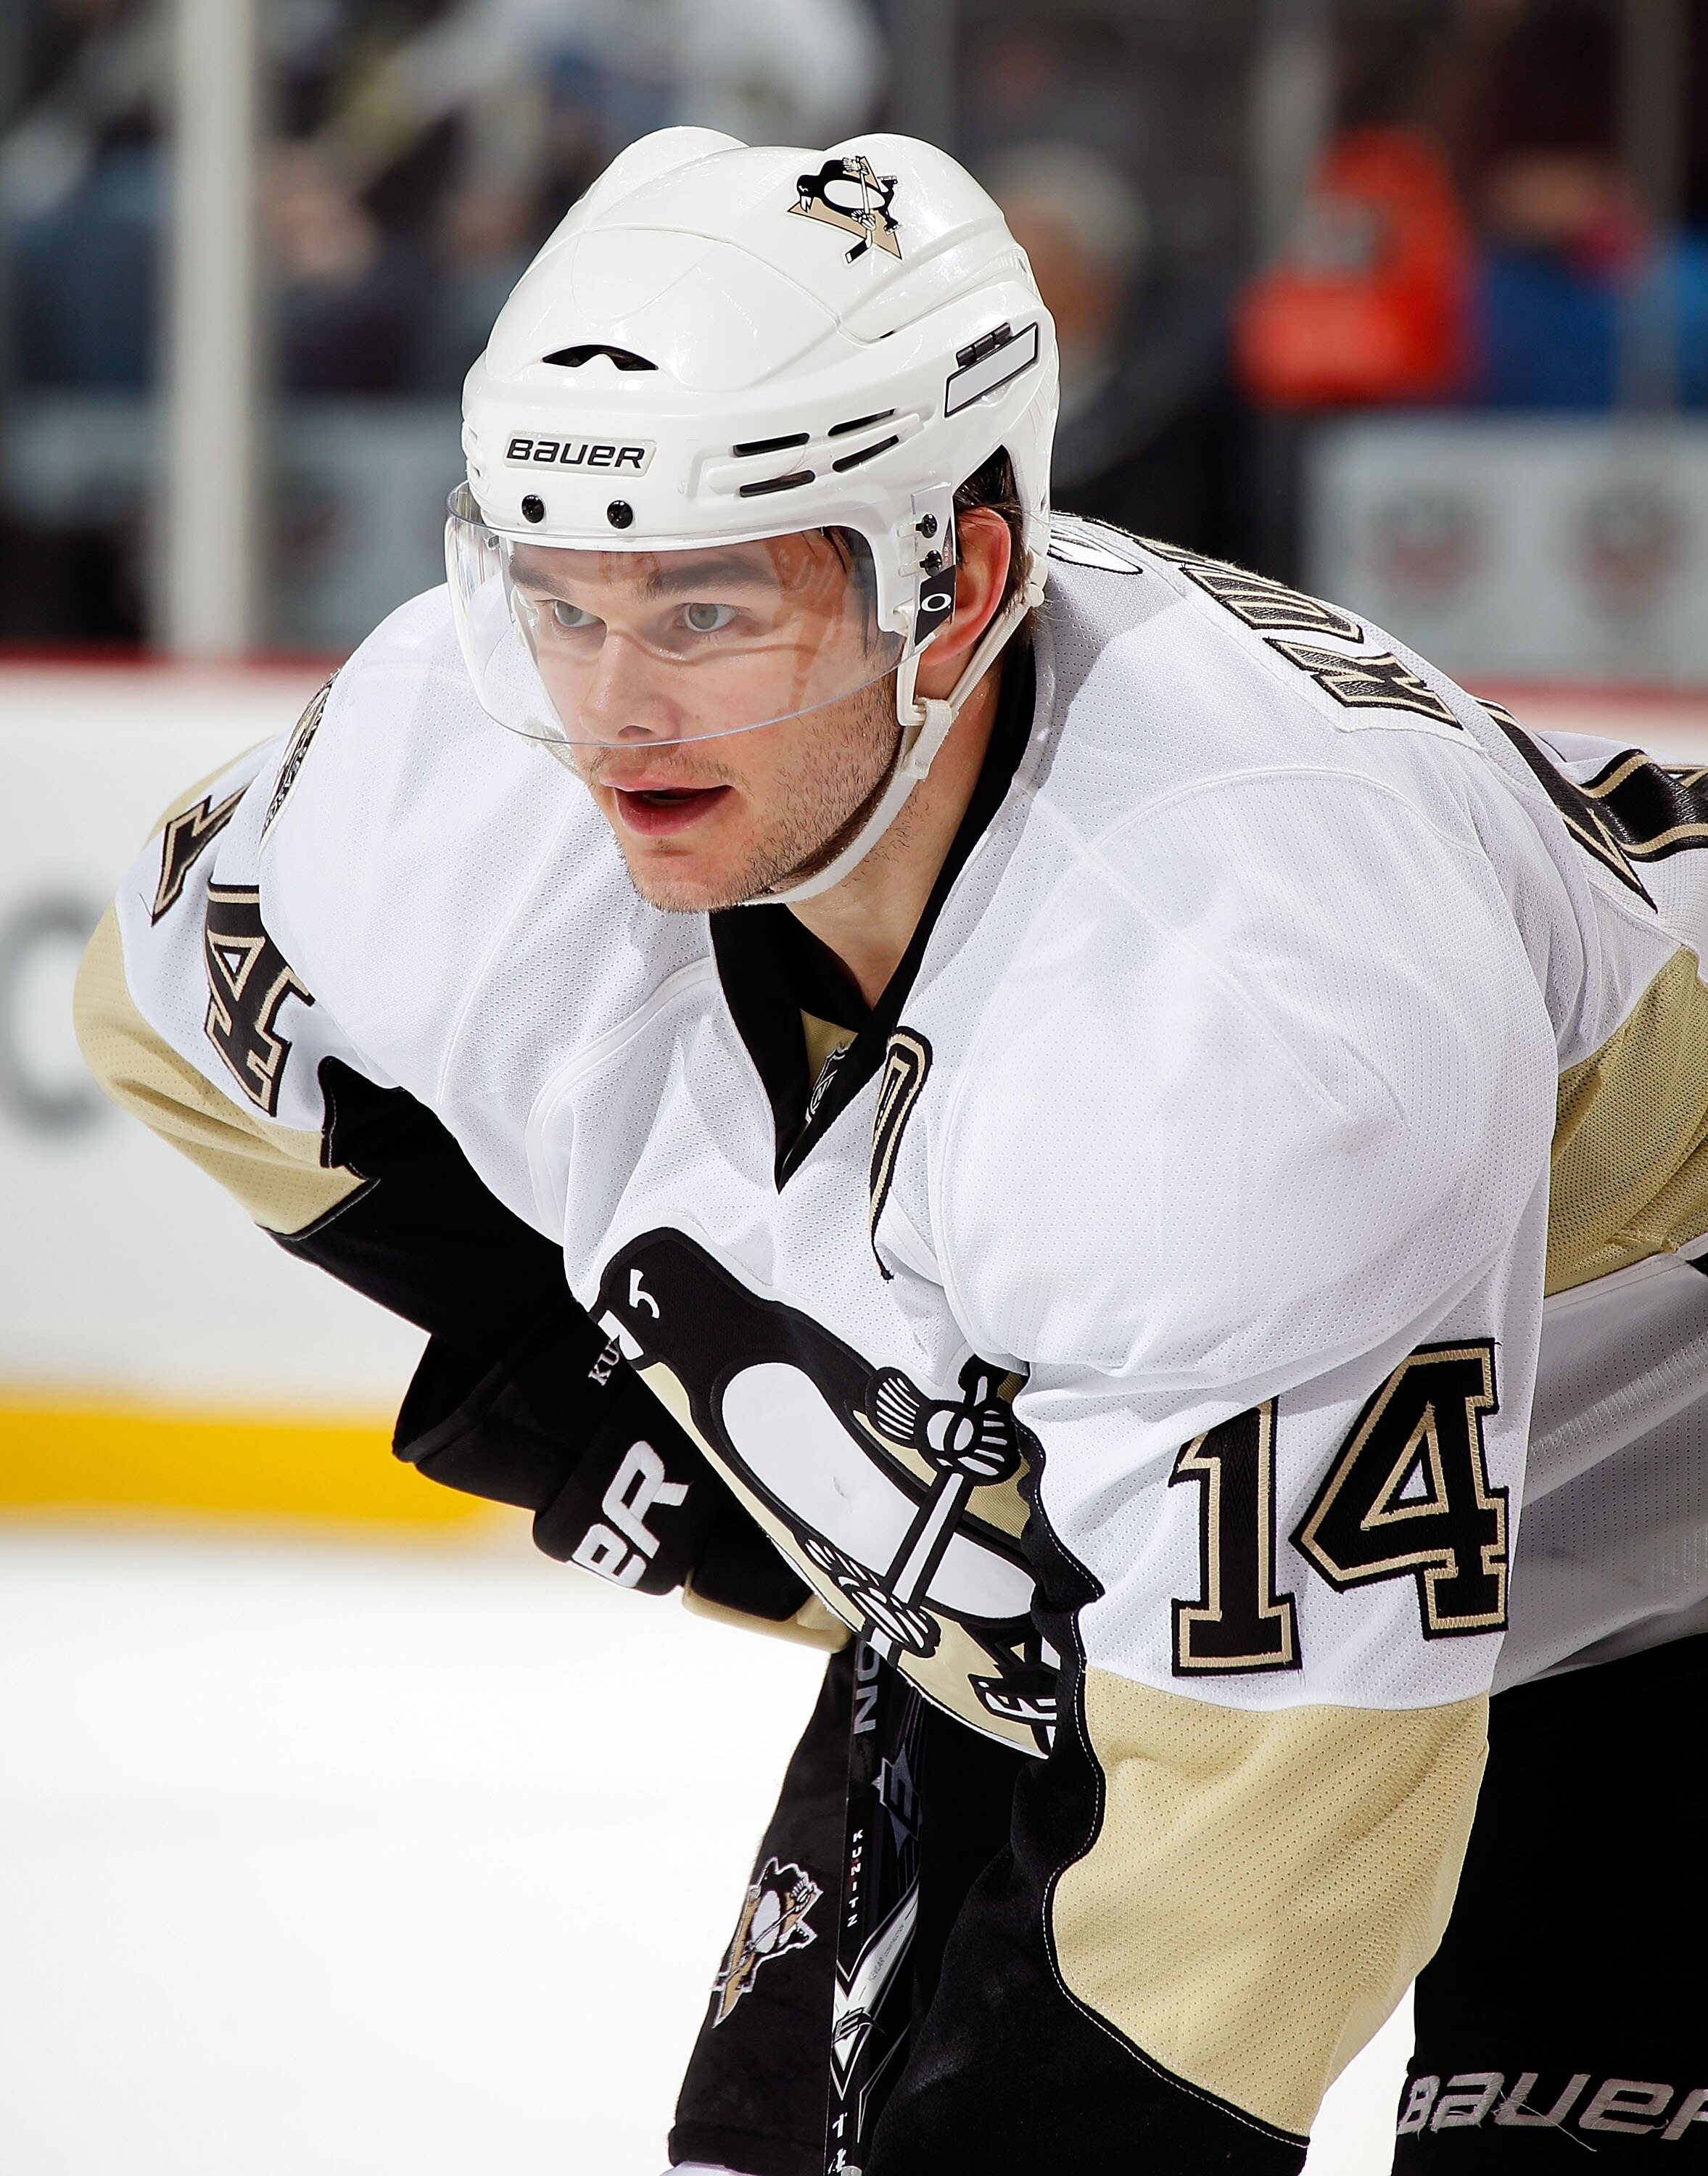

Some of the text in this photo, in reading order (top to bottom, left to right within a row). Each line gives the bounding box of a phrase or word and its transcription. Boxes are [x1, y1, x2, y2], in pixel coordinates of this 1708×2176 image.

[506, 438, 645, 469] BAUER
[1168, 1338, 1509, 1677] 14
[846, 1829, 864, 1927] KUNITZ
